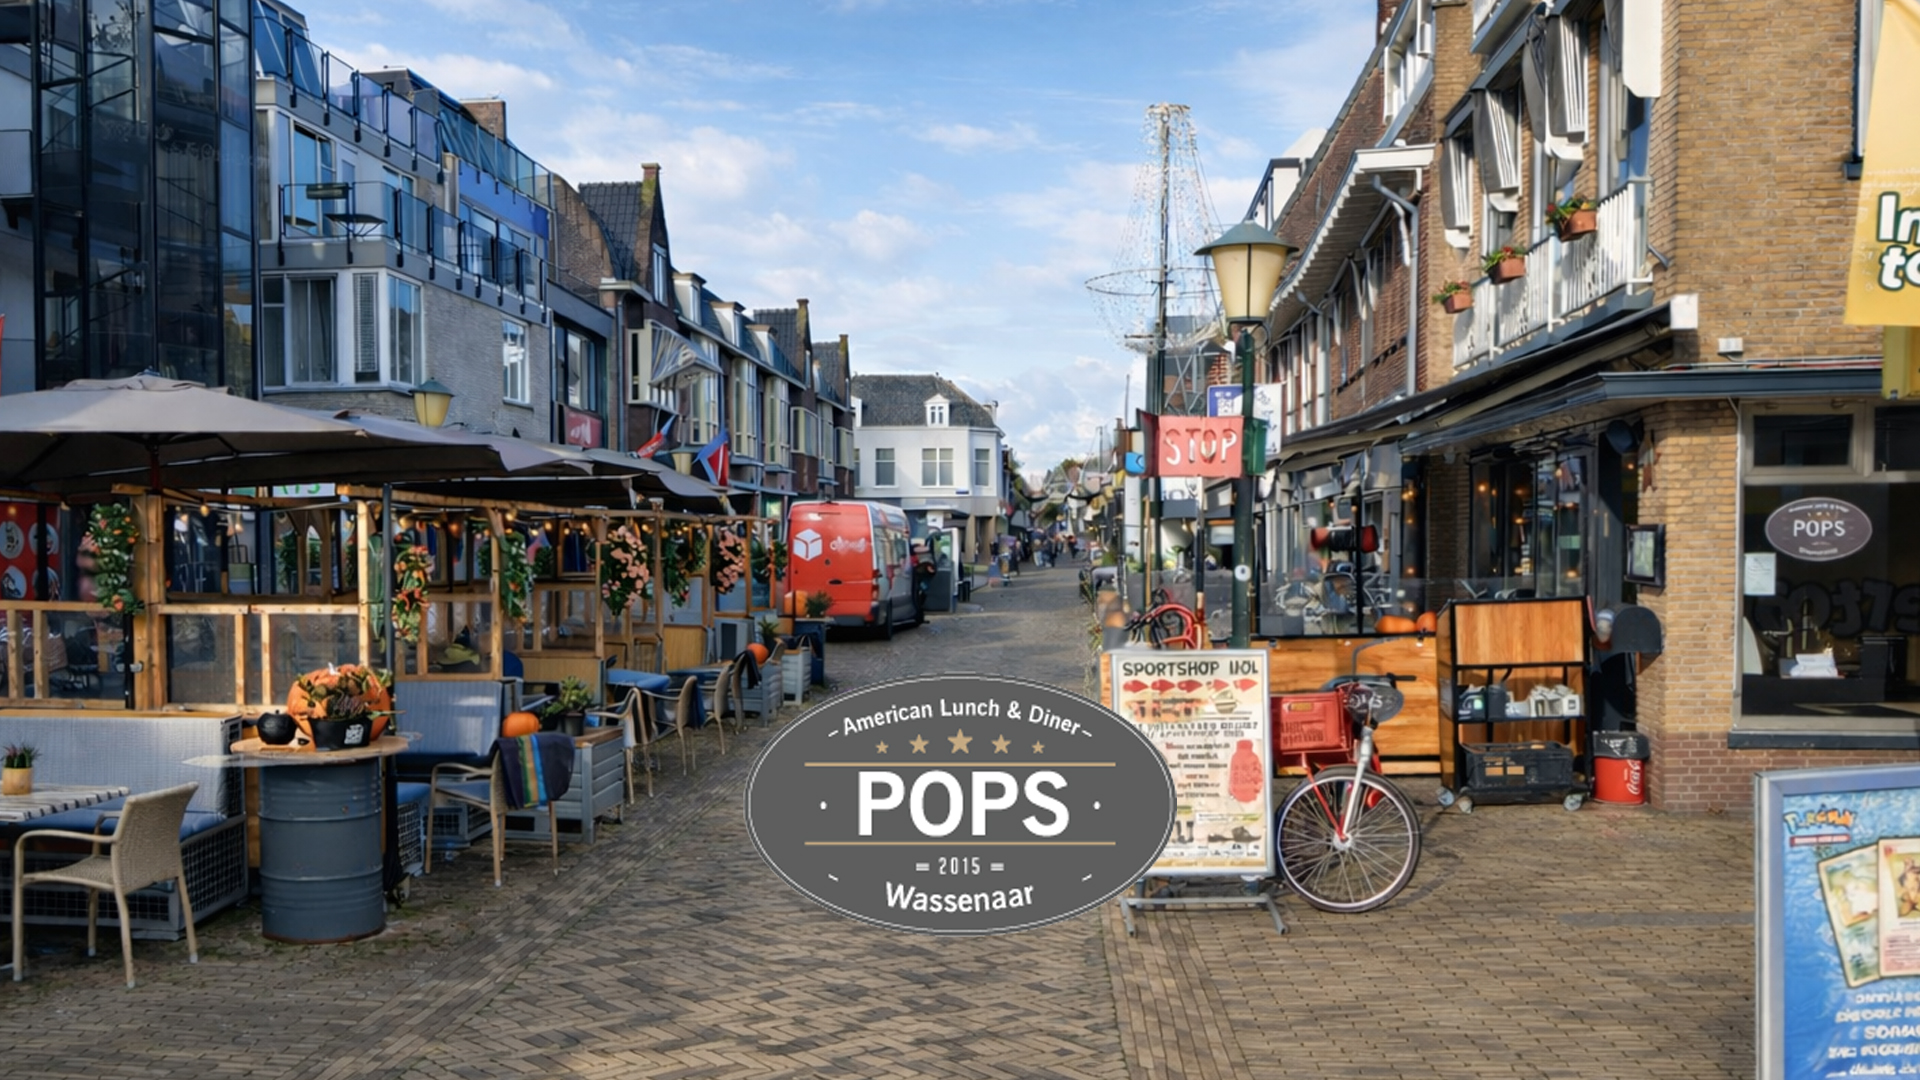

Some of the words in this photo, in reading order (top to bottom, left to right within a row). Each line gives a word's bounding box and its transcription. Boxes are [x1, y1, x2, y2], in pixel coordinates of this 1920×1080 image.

[1165, 428, 1238, 465] STOP
[1793, 519, 1846, 537] POPS
[1122, 660, 1220, 676] SPORTSHOP
